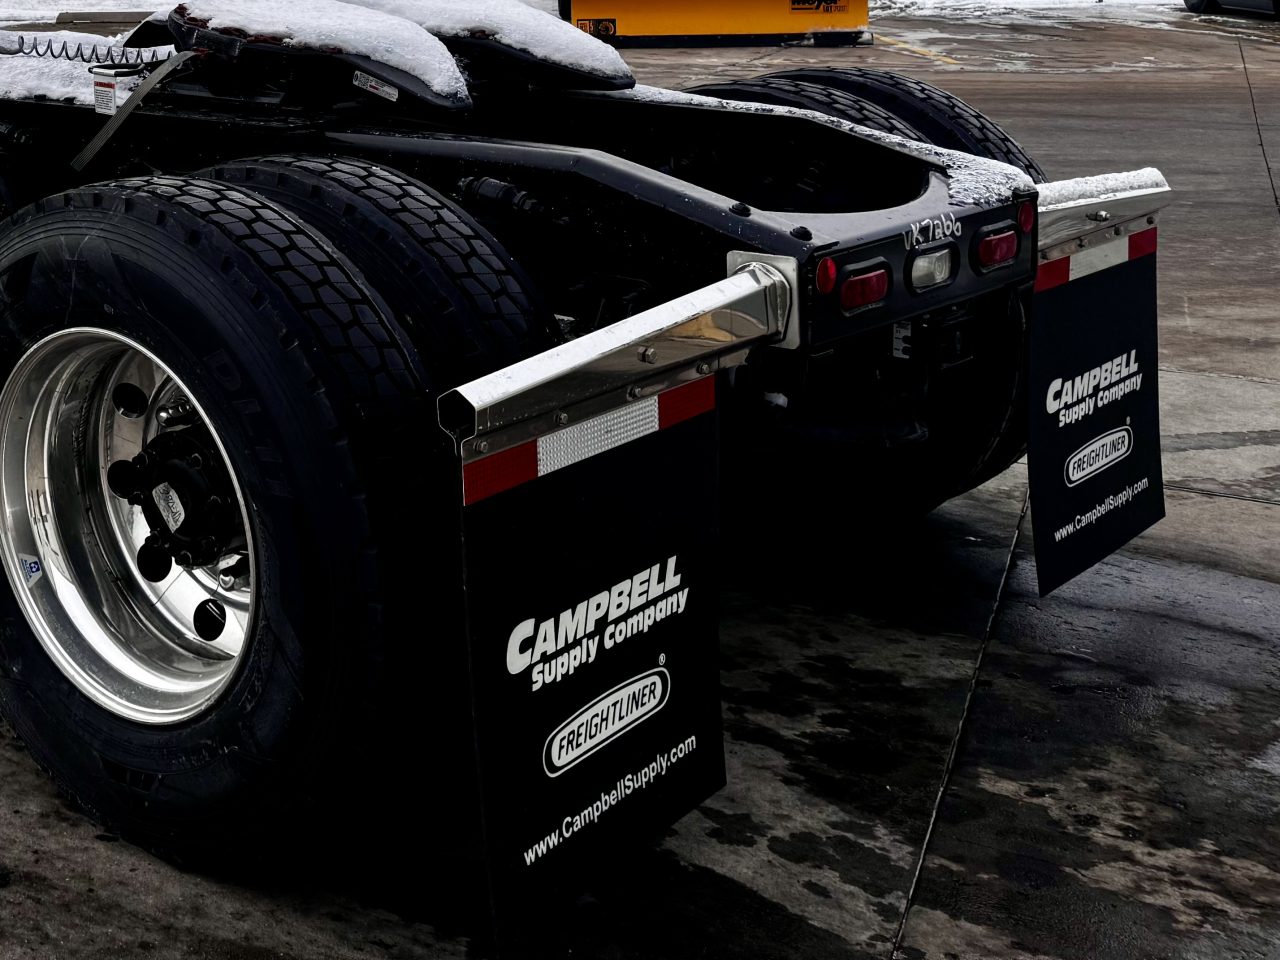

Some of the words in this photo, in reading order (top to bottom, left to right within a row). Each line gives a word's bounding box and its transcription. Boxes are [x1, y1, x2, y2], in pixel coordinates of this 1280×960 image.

[1046, 349, 1138, 414] CAMPBELL
[1058, 395, 1096, 428] Supply
[1097, 373, 1143, 408] Company
[1071, 434, 1127, 478] FREIGHTLINER
[1054, 477, 1149, 542] www.CampbellSupply.com
[505, 555, 683, 675] CAMPBELL
[531, 634, 600, 692] Supply
[603, 586, 690, 650] Company
[556, 680, 659, 762] FREIGHTLINER
[523, 733, 698, 867] www.CampbellSupply.com
